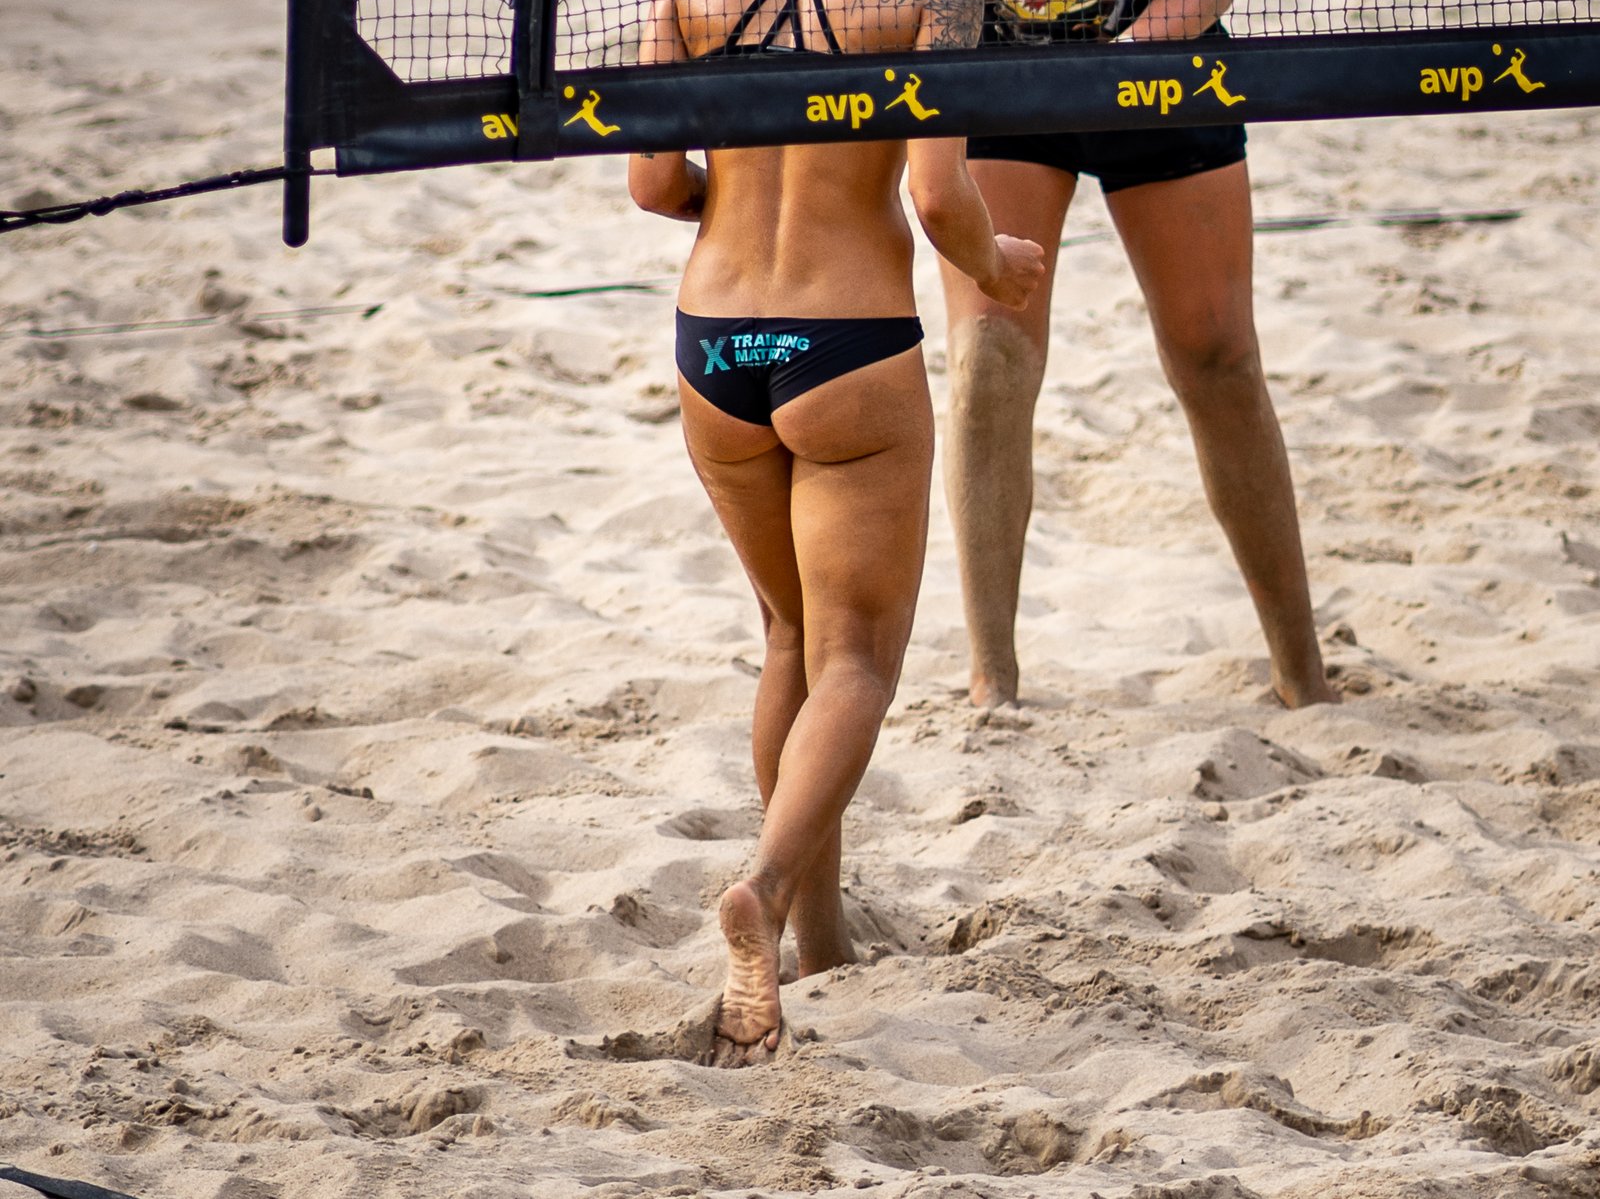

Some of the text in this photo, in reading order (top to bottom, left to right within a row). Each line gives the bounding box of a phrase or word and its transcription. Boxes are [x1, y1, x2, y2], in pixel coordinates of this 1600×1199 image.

[1117, 78, 1182, 115] avp
[1419, 64, 1483, 102] avp
[482, 113, 519, 140] av
[806, 92, 874, 130] avp
[731, 333, 811, 351] TRAINING
[735, 347, 791, 363] MATRIX
